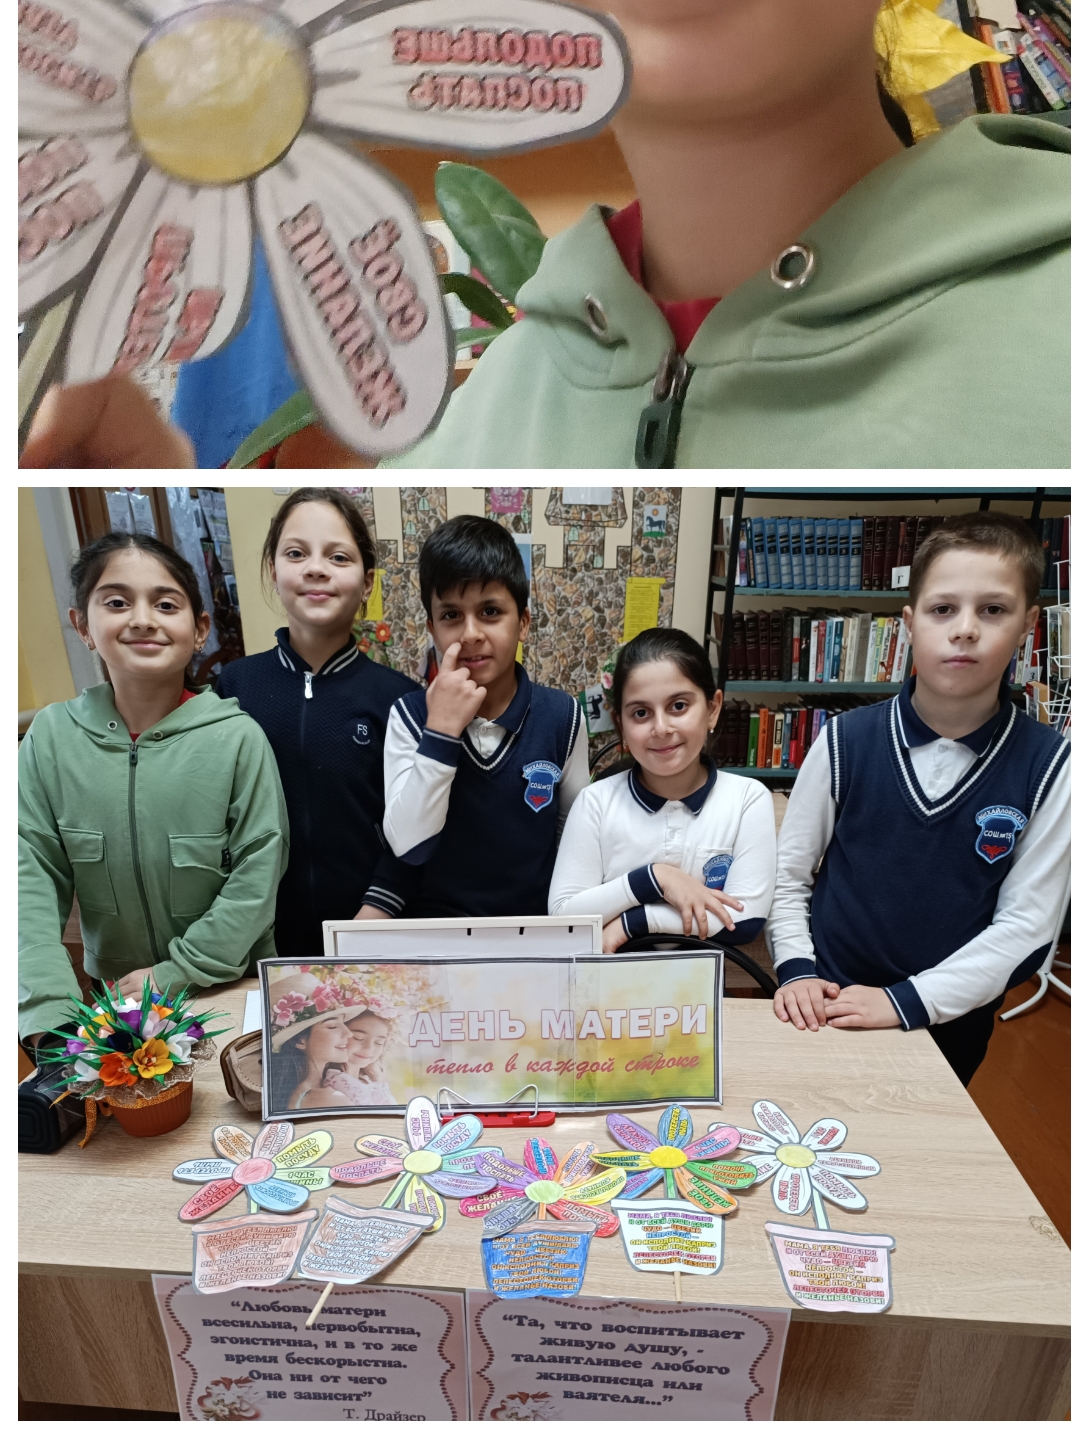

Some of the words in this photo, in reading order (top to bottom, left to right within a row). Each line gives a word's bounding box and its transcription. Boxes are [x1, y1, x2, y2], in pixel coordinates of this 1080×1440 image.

[357, 724, 368, 735] FS
[978, 807, 1025, 824] МИХАЙЛОВСКАЯ
[409, 1010, 526, 1047] ДЕНЬ
[541, 1004, 707, 1040] МАТЕРИ
[426, 1058, 494, 1075] тепло
[504, 1053, 520, 1073] в
[526, 1056, 615, 1080] каждой
[624, 1053, 700, 1076] строке
[700, 1165, 754, 1178] ПРИГОТОВИТЬ
[713, 1175, 737, 1185] УЖИН
[320, 1306, 386, 1318] матери
[202, 1318, 297, 1332] всесильна,
[554, 1319, 593, 1332] что
[601, 1322, 745, 1341] воспитывает
[210, 1334, 318, 1350] эгоистична,
[325, 1340, 337, 1349] и
[344, 1341, 355, 1350] в
[362, 1341, 384, 1351] то
[391, 1342, 418, 1352] же
[539, 1336, 616, 1351] живую
[623, 1342, 688, 1357] душу,
[224, 1352, 279, 1365] время
[285, 1351, 408, 1369] бескорыстна.
[511, 1352, 642, 1369] талантливее
[651, 1360, 730, 1376] любого
[249, 1370, 283, 1382] Она
[289, 1373, 313, 1383] ни
[320, 1374, 341, 1383] от
[347, 1375, 387, 1386] чего
[535, 1370, 654, 1389] живописца
[662, 1380, 703, 1391] или
[265, 1390, 287, 1400] не
[342, 1408, 355, 1420] Т.
